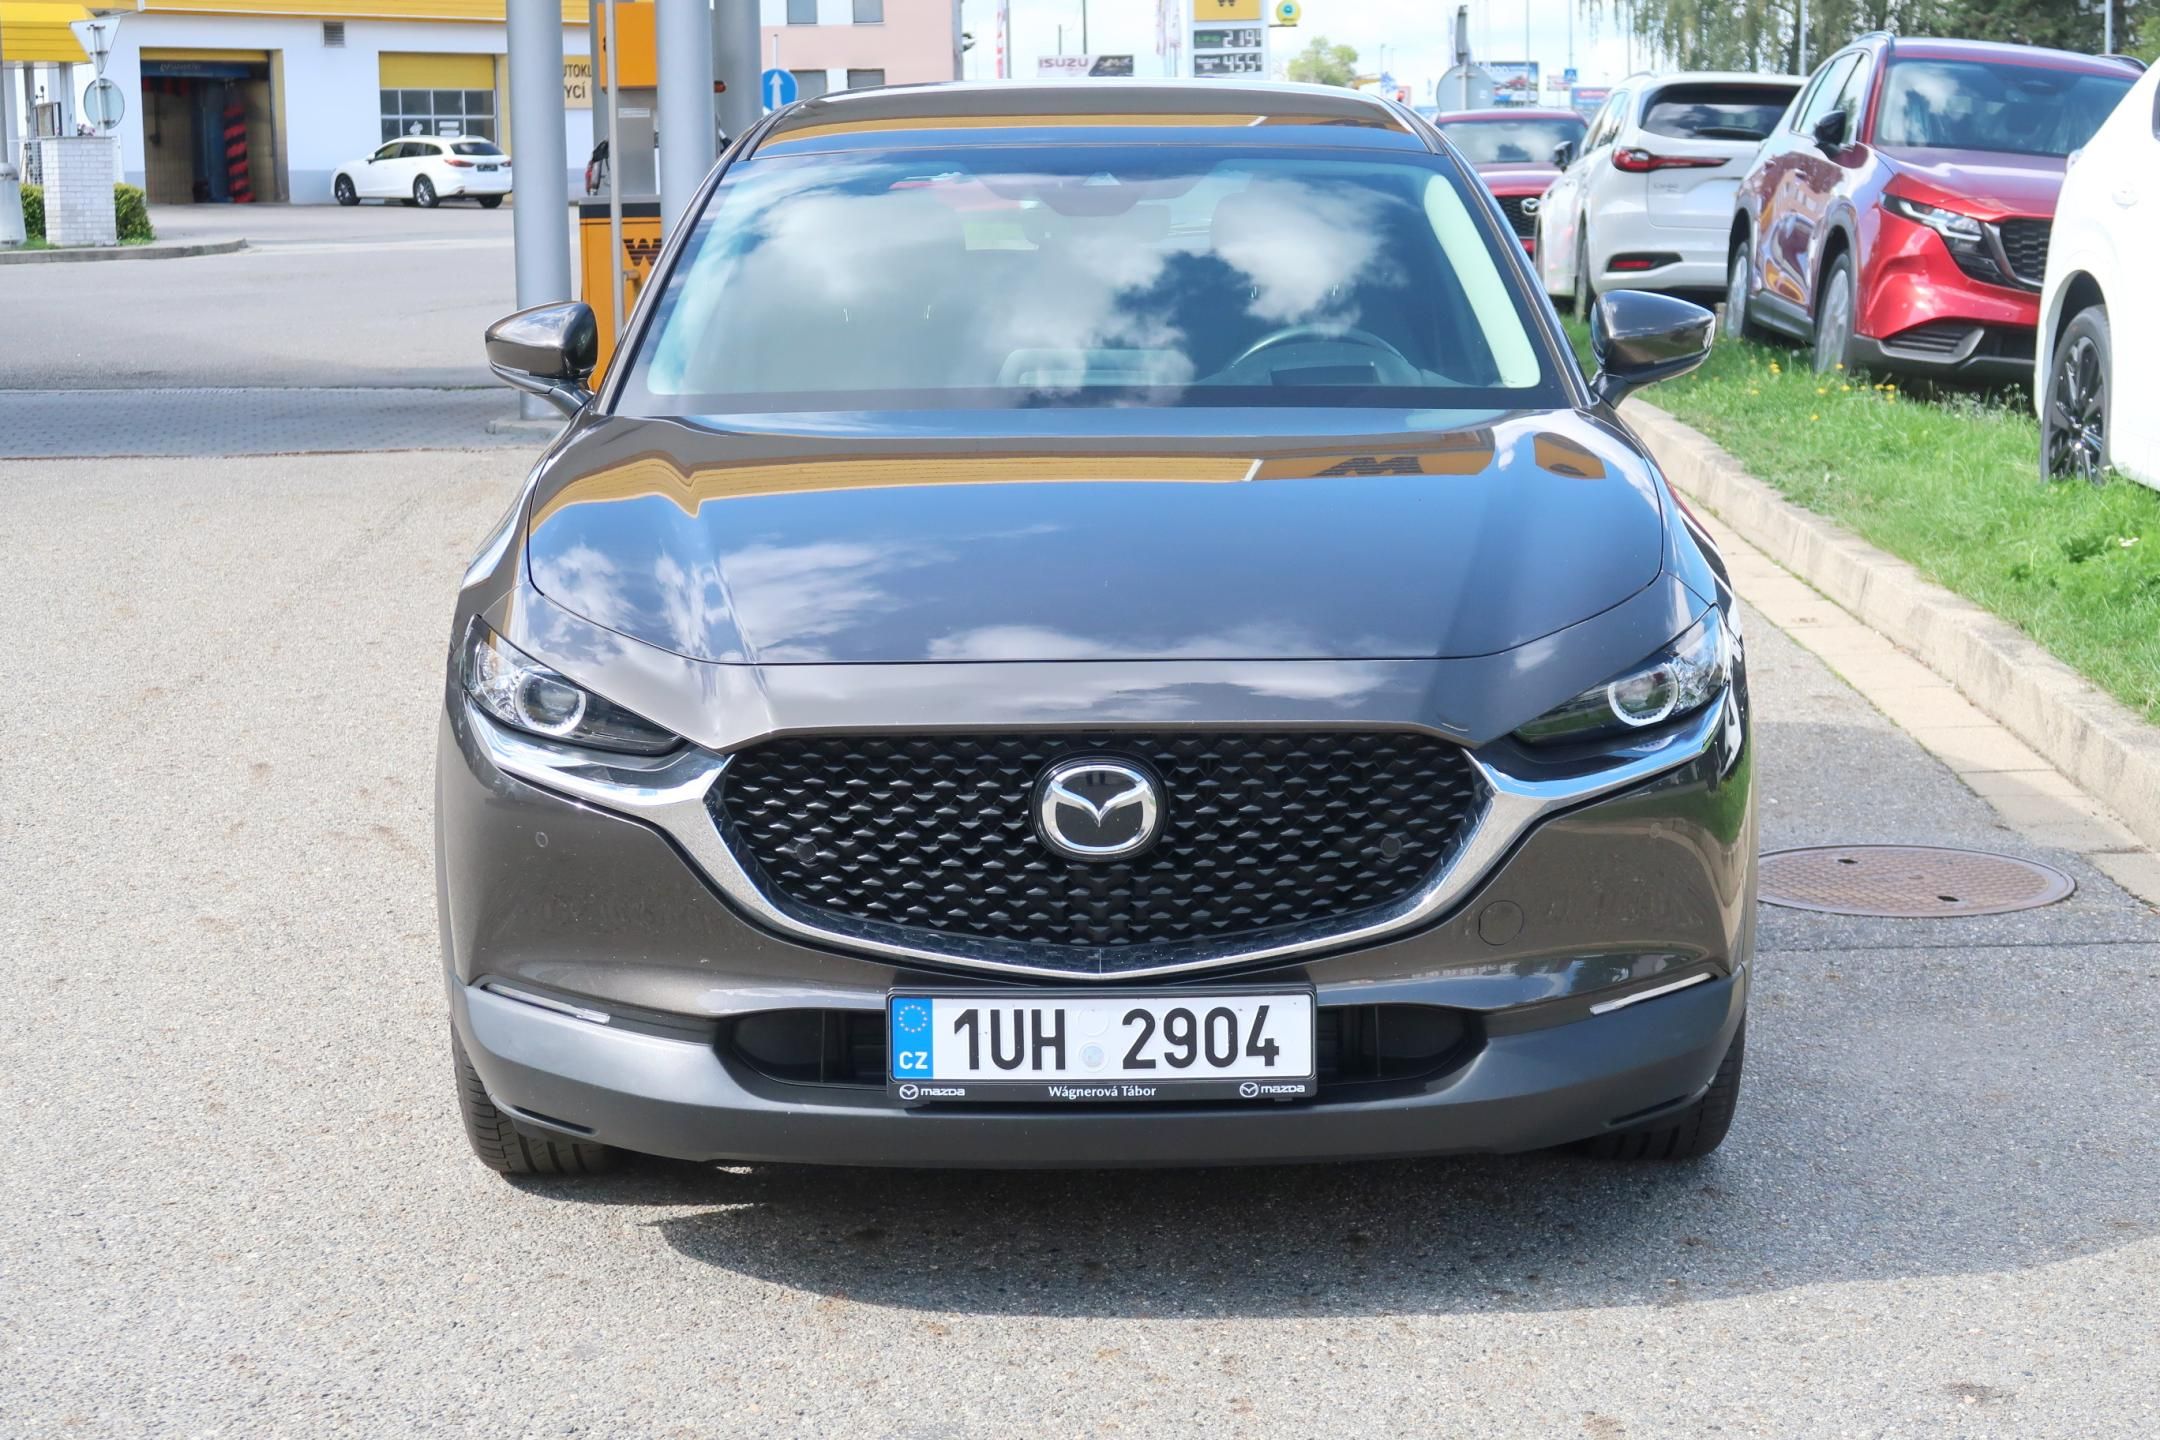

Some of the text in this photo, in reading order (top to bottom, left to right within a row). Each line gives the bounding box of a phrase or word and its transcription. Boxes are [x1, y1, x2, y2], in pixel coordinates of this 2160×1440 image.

[1039, 57, 1089, 68] ISUZU
[953, 1005, 1280, 1071] 1UH 2904
[899, 1051, 929, 1070] CZ
[920, 1087, 966, 1096] mazda
[1048, 1084, 1157, 1100] Wágnerová Tábor
[1260, 1084, 1306, 1093] mazda
